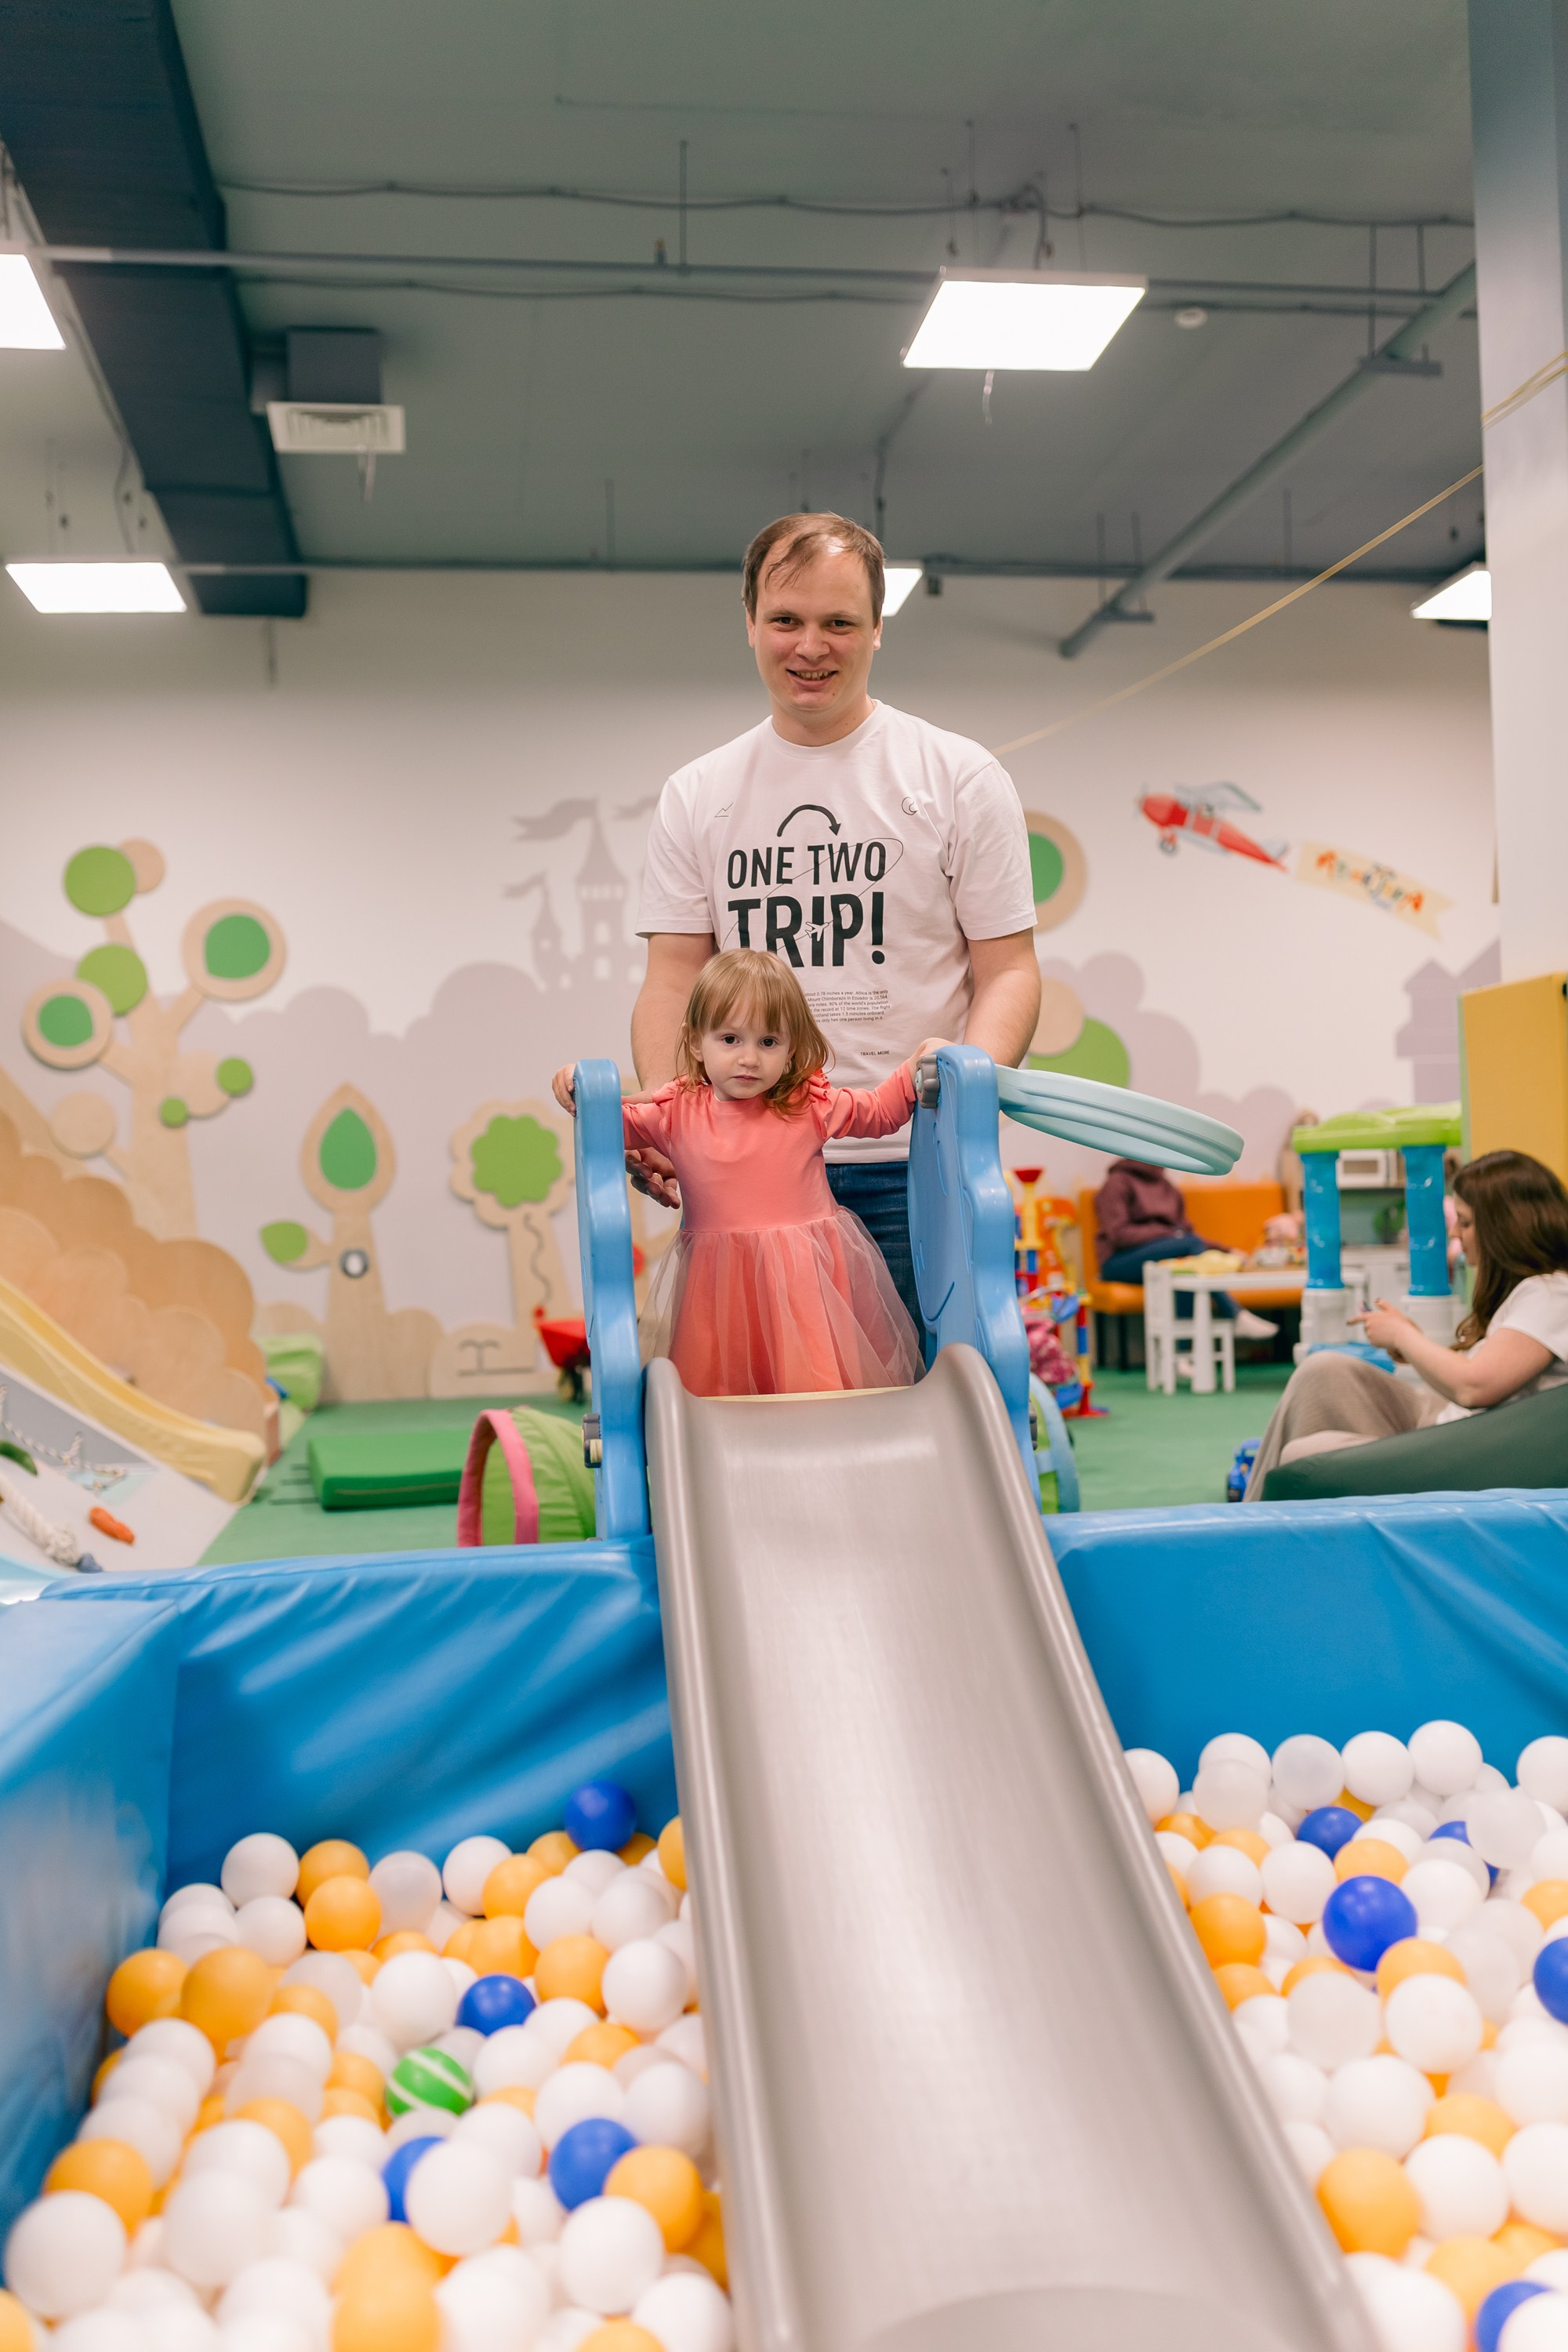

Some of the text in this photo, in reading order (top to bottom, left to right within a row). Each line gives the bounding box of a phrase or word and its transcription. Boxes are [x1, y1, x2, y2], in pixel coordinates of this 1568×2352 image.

[728, 842, 886, 889] ONE TWO
[728, 891, 885, 968] TRIP!
